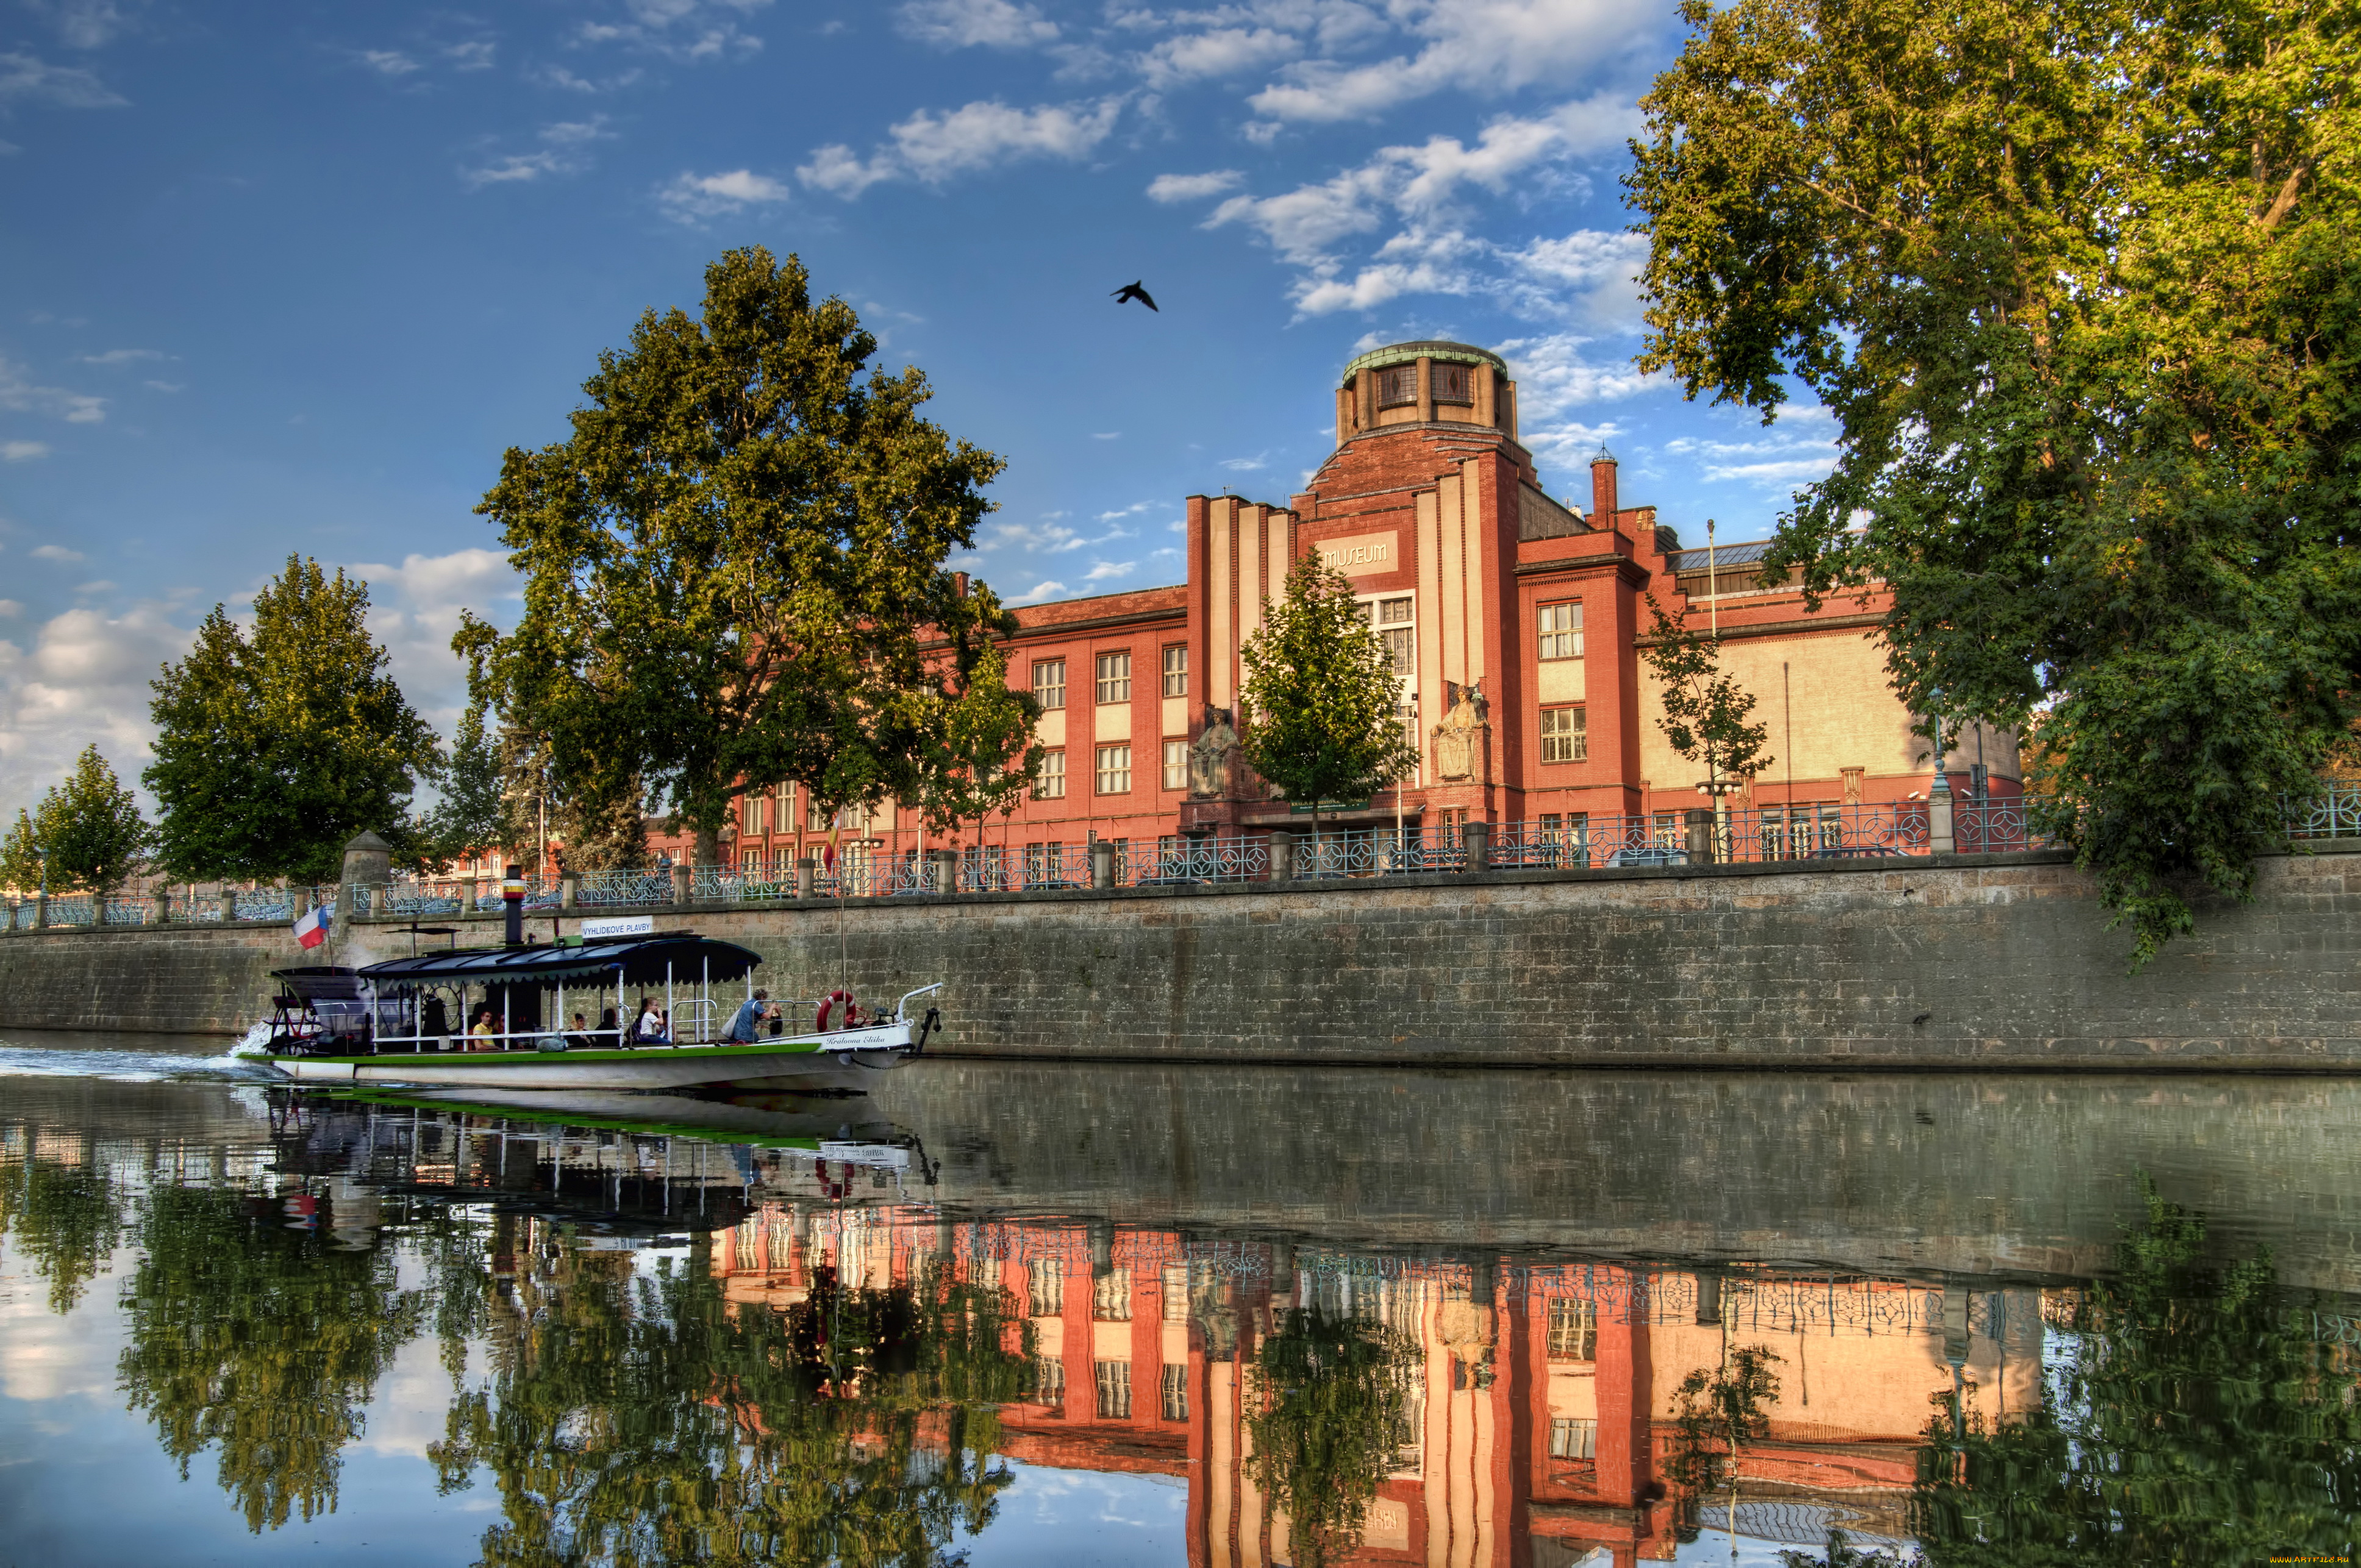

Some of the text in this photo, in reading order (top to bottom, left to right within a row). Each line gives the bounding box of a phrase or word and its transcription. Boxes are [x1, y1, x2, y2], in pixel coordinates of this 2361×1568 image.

[1324, 544, 1388, 568] MUSEUM
[583, 923, 650, 935] VYHLÍDKOVÉ PLAVBY
